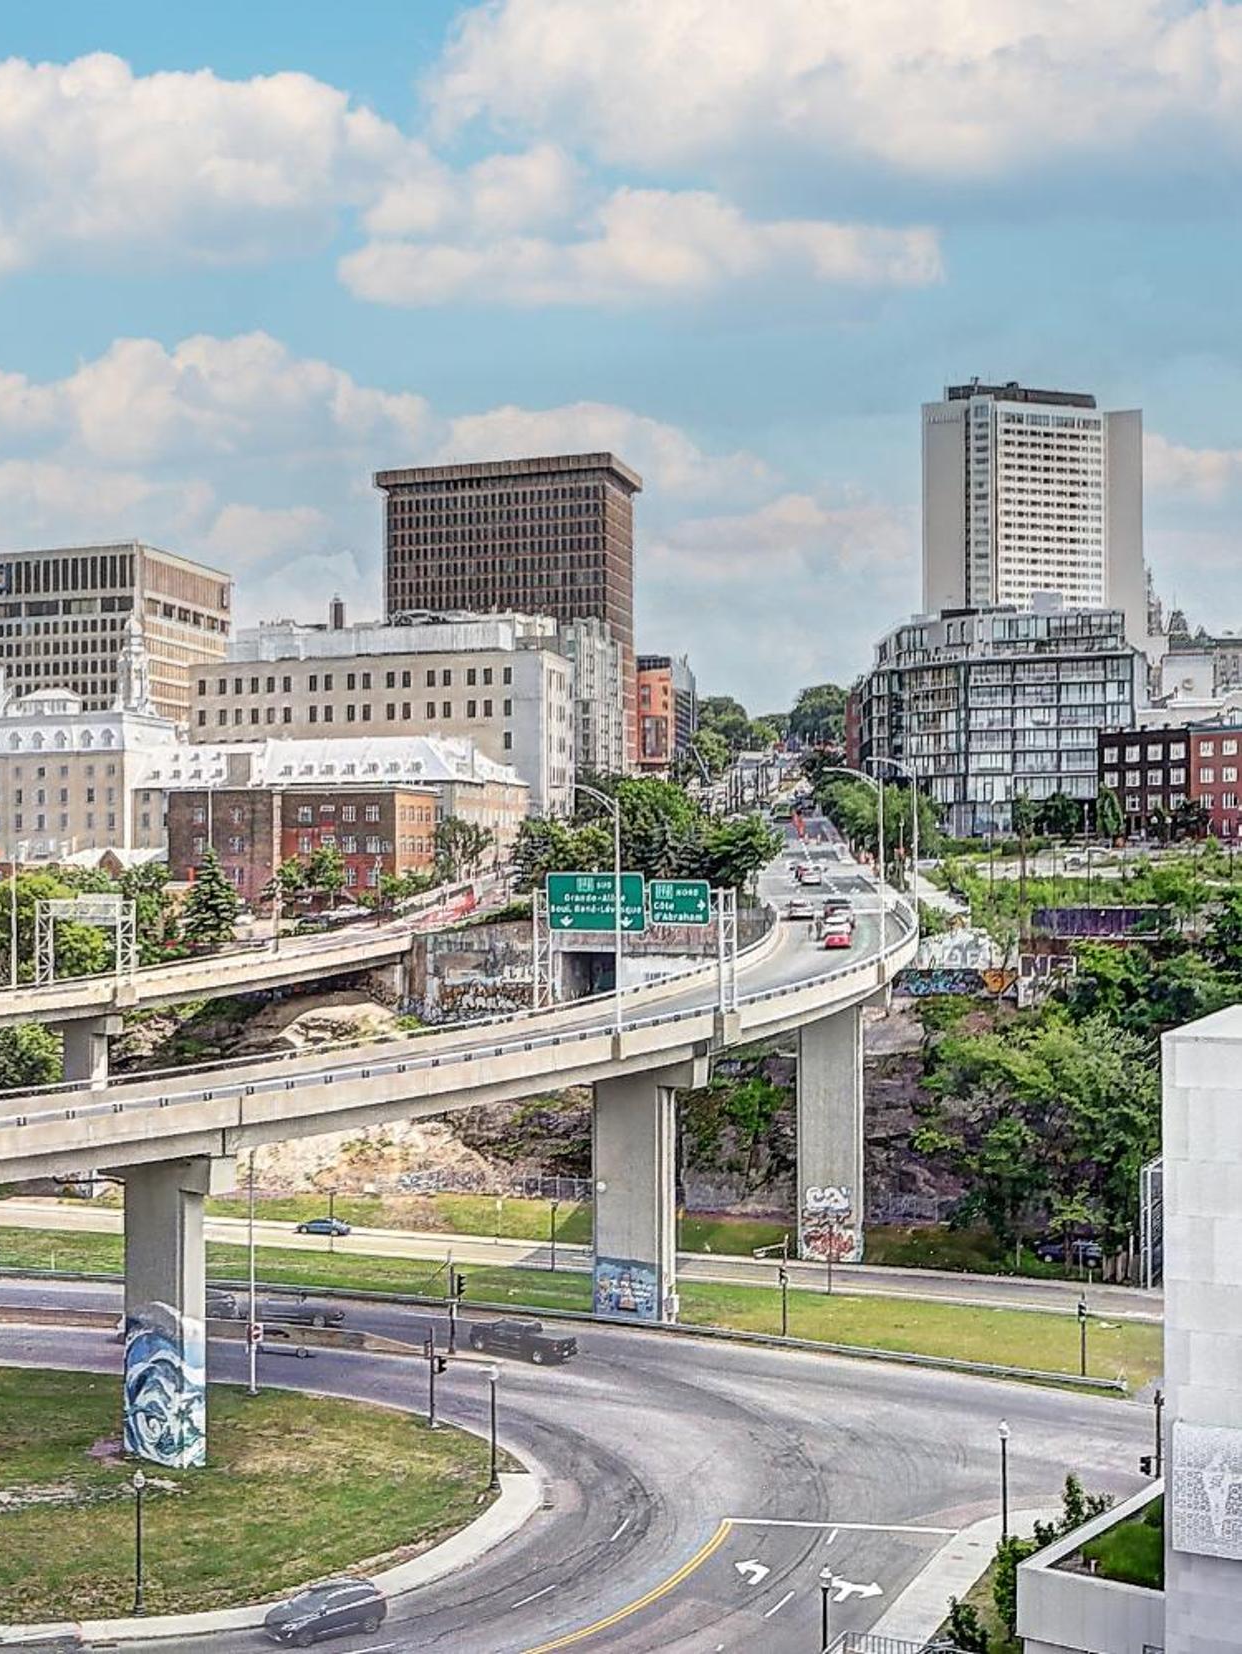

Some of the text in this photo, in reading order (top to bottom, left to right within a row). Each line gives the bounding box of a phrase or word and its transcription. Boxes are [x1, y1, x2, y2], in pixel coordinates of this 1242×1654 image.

[675, 888, 699, 897] NORD
[564, 893, 626, 902] Grande-Alle
[653, 900, 675, 910] Côte
[653, 911, 704, 921] d'Abraham
